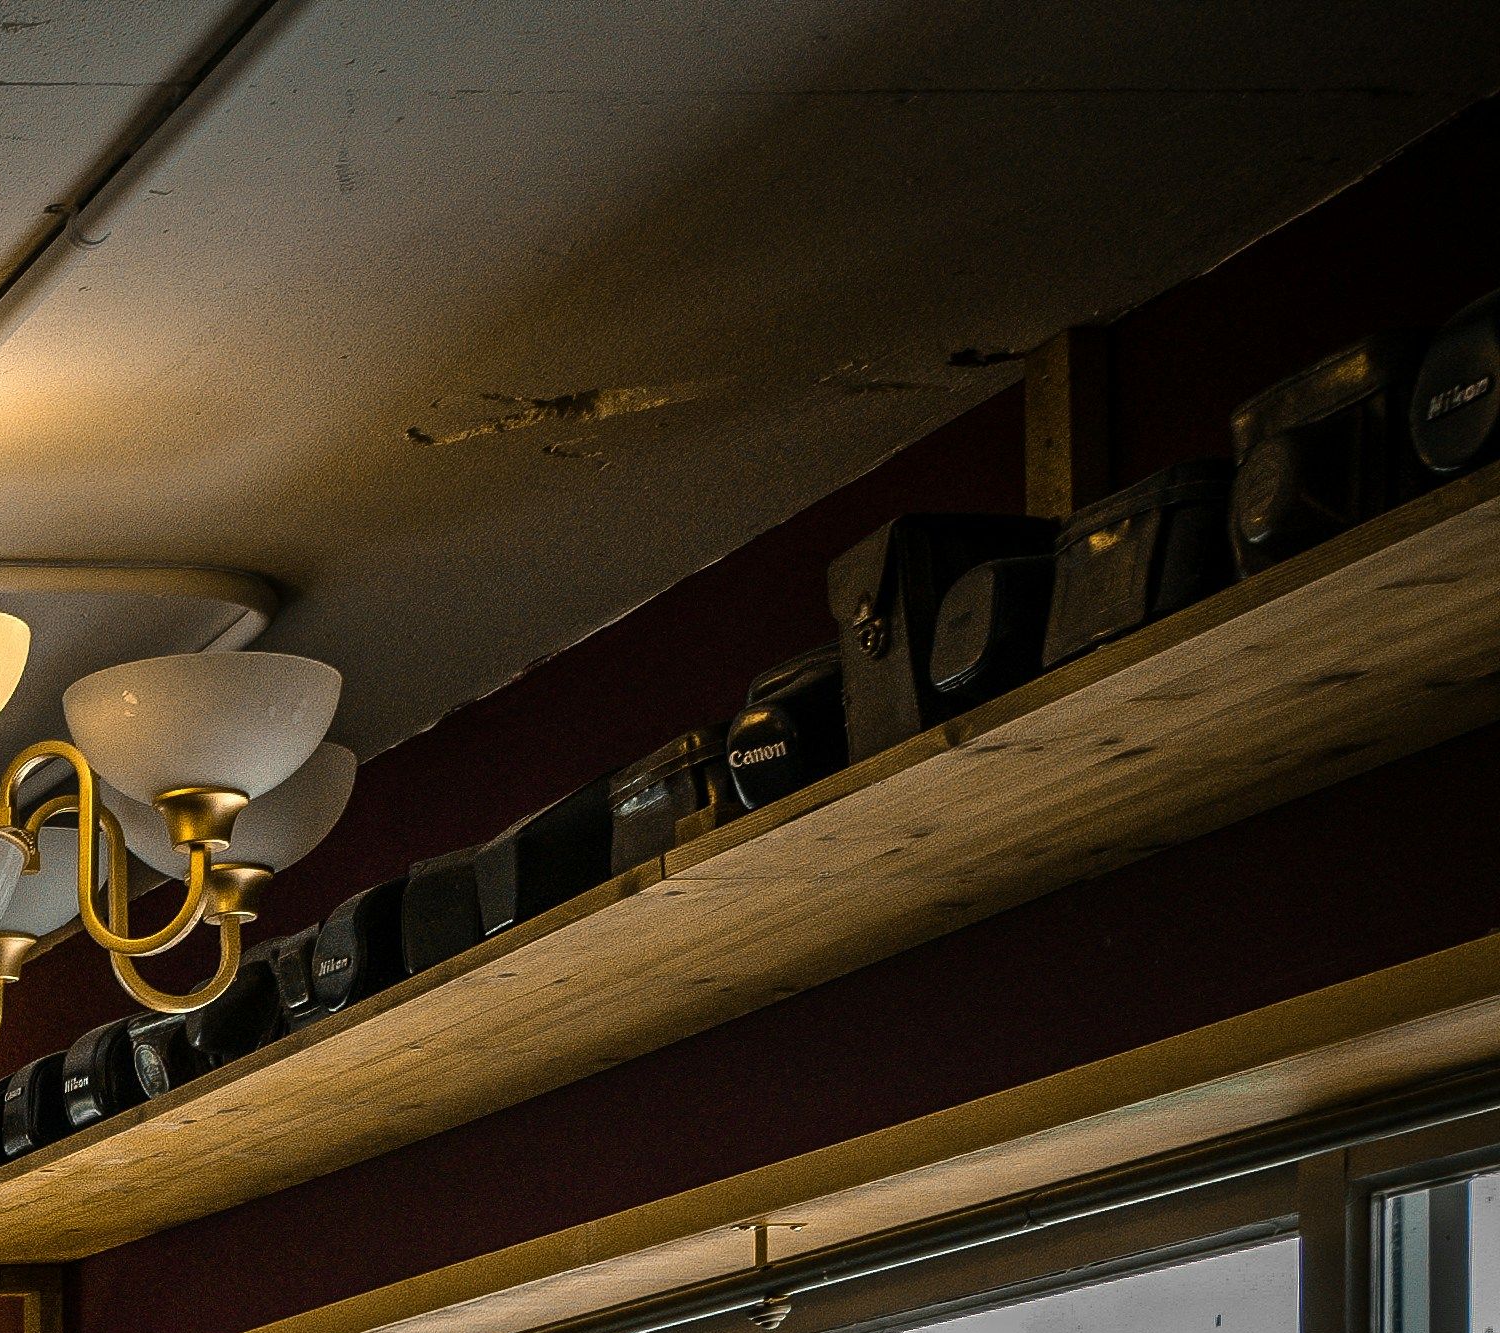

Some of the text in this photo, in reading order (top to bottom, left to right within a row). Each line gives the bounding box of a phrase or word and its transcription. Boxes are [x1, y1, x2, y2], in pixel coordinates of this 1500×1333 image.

[728, 741, 787, 768] Canon
[317, 957, 349, 977] Nikon
[64, 1076, 89, 1094] Nikon
